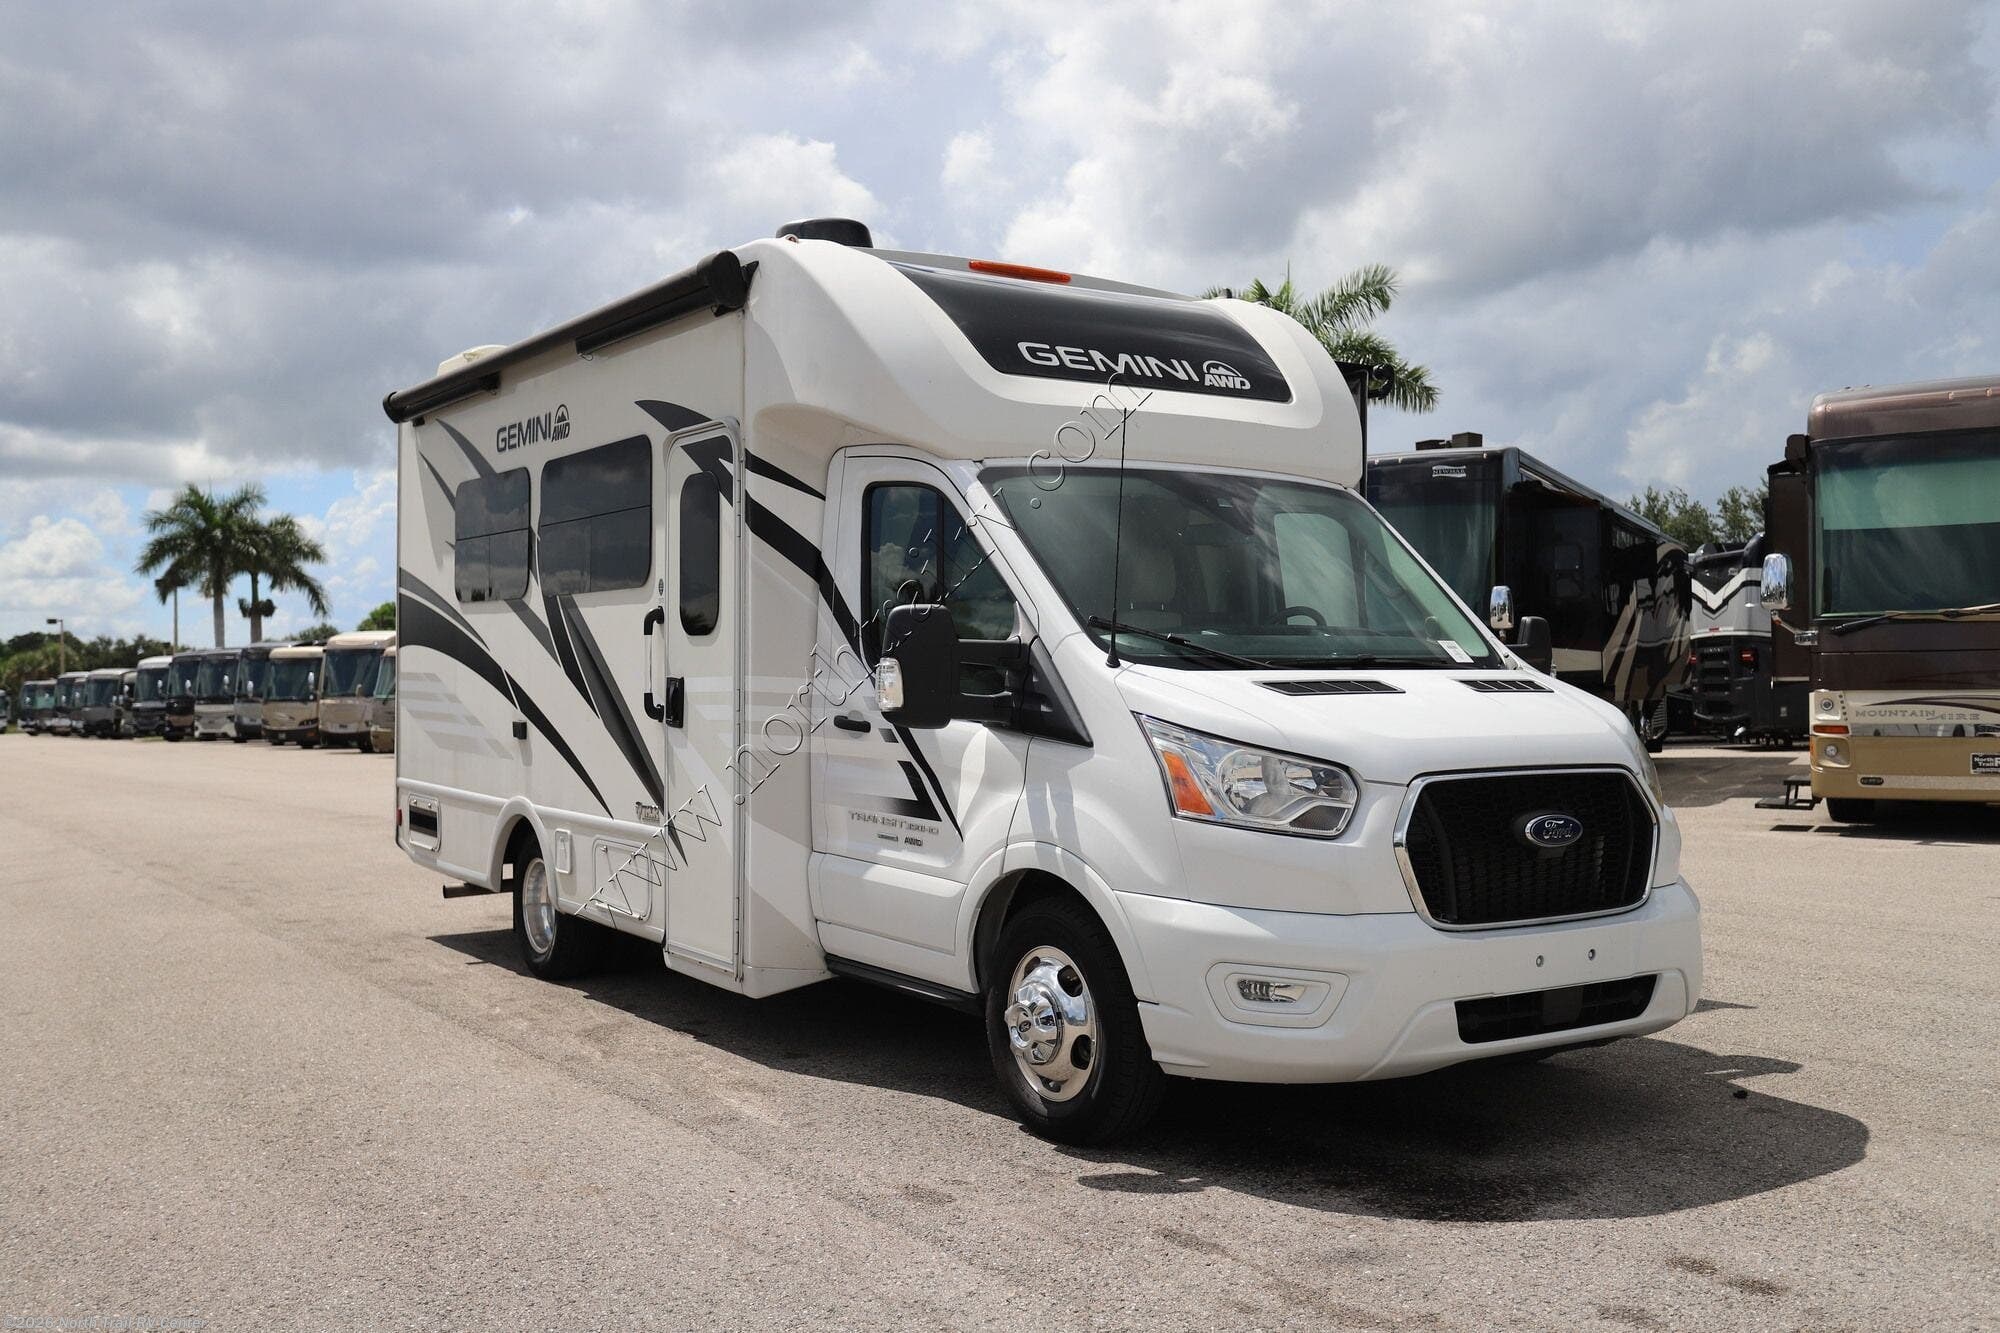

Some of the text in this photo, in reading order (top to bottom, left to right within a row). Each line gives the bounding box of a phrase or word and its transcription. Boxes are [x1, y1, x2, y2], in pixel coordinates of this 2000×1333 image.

[1017, 341, 1251, 390] GEMINI AWD
[496, 411, 571, 453] GEMINI AWD
[1855, 709, 1936, 718] MOUNTAIN
